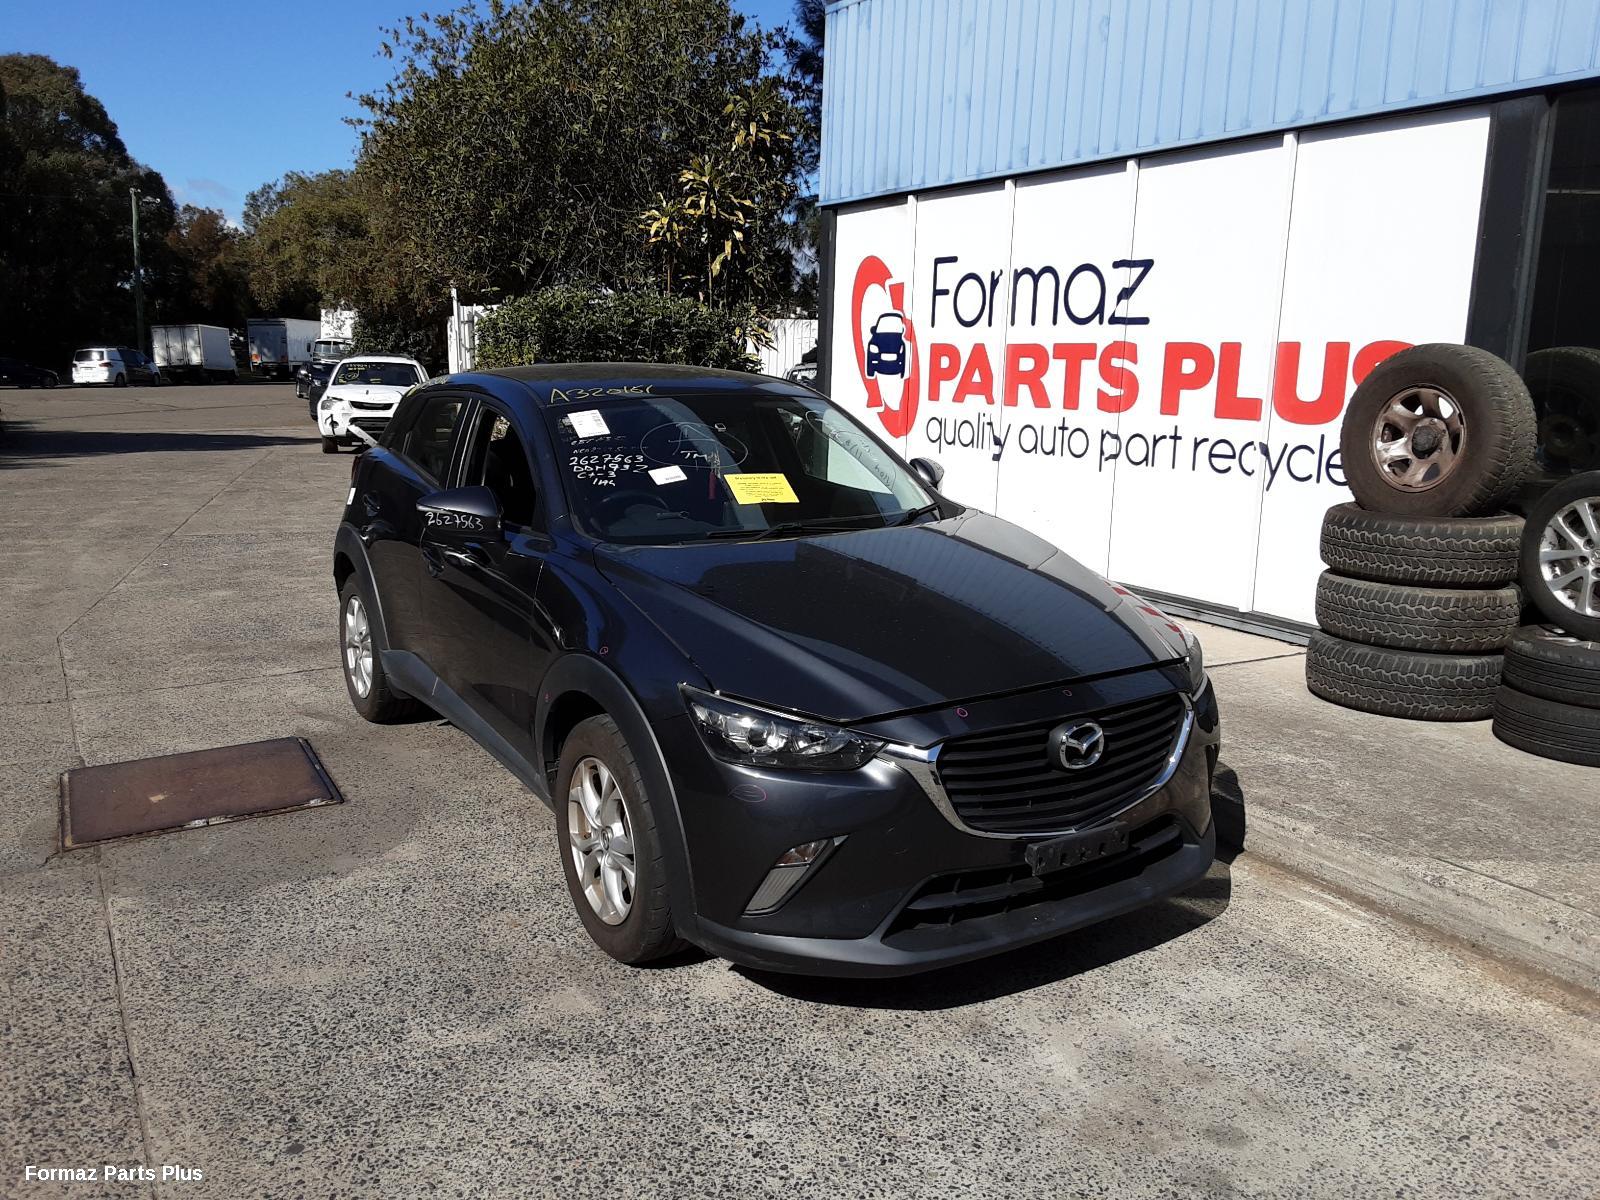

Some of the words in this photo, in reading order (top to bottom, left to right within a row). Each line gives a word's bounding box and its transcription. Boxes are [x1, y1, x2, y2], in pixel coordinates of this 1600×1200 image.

[930, 255, 1155, 328] Formaz
[928, 340, 1140, 414] PARTS
[568, 453, 644, 466] 2627563
[926, 412, 1011, 462] quality
[1018, 416, 1090, 459] auto
[1098, 425, 1183, 473] part
[424, 511, 484, 531] 2627563
